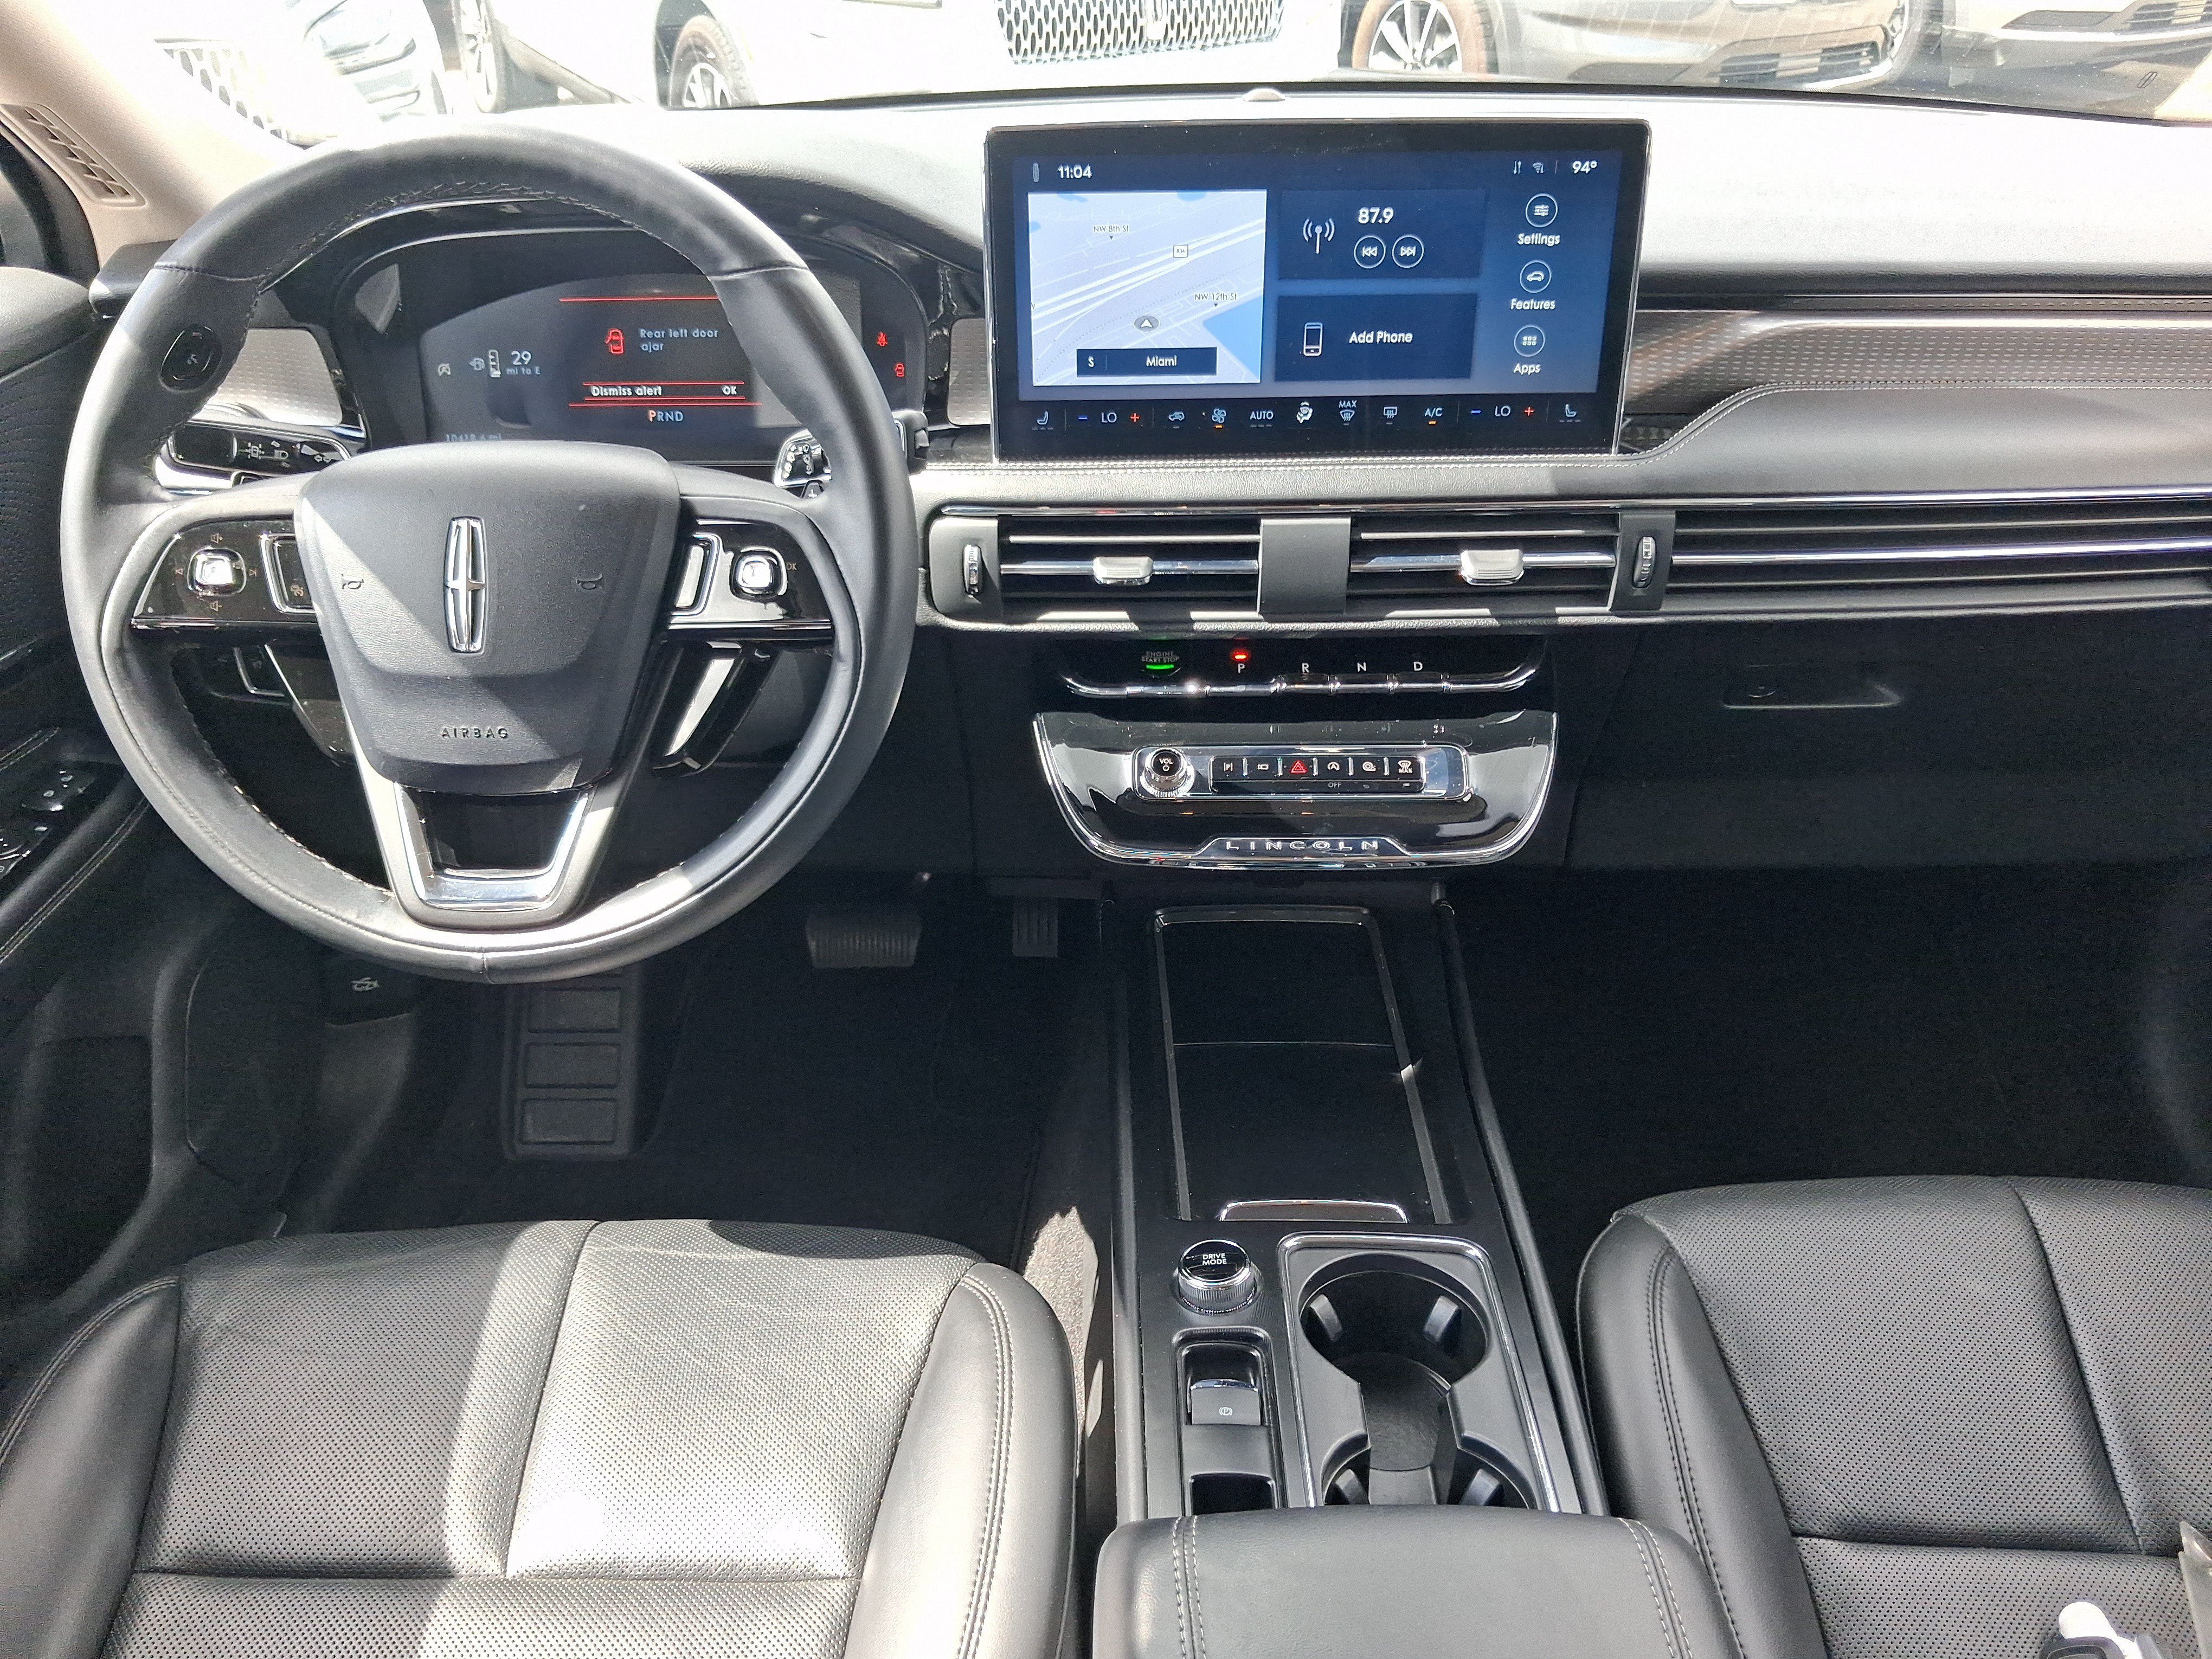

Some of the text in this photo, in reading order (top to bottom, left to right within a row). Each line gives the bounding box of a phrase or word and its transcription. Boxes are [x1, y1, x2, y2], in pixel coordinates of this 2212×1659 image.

[1058, 164, 1092, 178] 11:04
[1358, 208, 1393, 224] 87.9
[1517, 233, 1560, 246] Settings
[1510, 298, 1556, 310] Features
[640, 328, 718, 338] Rear left door
[1348, 330, 1413, 343] Add Phone
[640, 342, 664, 352] ajar
[511, 350, 531, 365] 29
[1088, 356, 1095, 368] S
[1146, 355, 1177, 367] Miami
[1514, 363, 1541, 375] Apps
[591, 385, 662, 396] Dismiss alert
[722, 385, 737, 395] OK
[1250, 410, 1274, 420] AUTO
[1424, 407, 1443, 418] A/C
[1495, 406, 1511, 417] LO
[1101, 412, 1117, 423] LO
[1238, 663, 1245, 673] P
[1302, 663, 1309, 673] R
[1357, 662, 1366, 672] N
[1413, 661, 1423, 671] D
[441, 726, 509, 739] AIRBAG
[1226, 841, 1378, 851] LINCOLN
